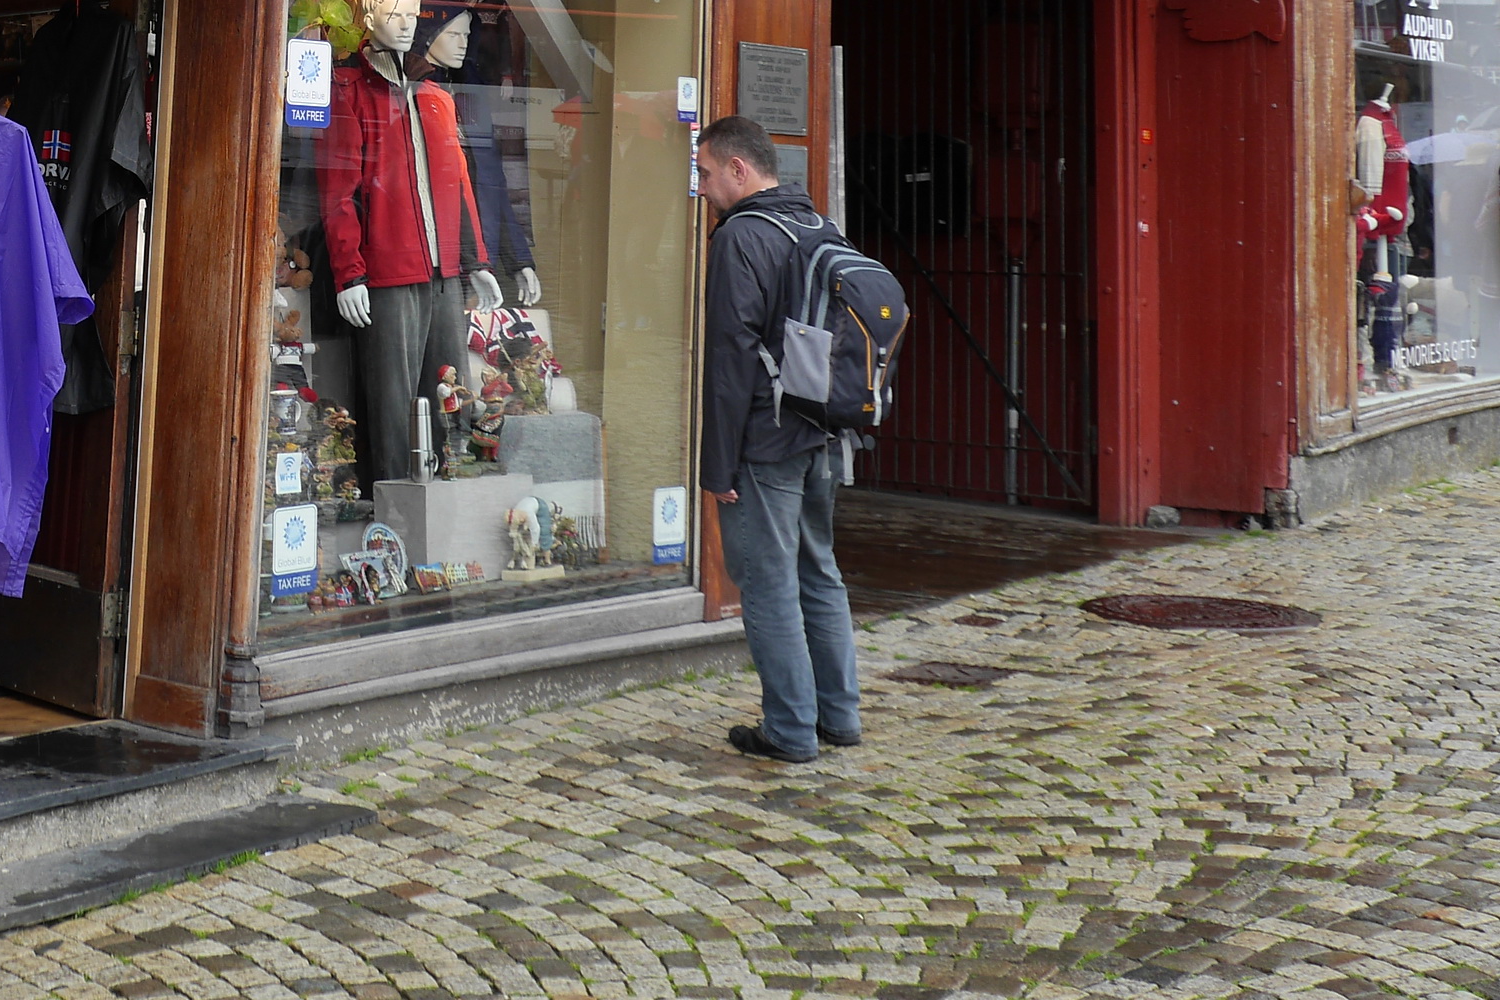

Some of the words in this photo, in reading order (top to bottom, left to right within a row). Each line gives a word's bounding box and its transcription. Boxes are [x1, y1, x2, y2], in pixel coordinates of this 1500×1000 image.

[1403, 13, 1453, 40] AUDHILD
[1410, 38, 1445, 62] VIKEN
[291, 109, 306, 121] TAX
[306, 109, 325, 122] FREE
[1391, 342, 1442, 369] MEMORIES
[1443, 342, 1451, 362] &
[1451, 338, 1477, 362] GIFTS
[277, 557, 297, 568] Global
[297, 555, 312, 565] Blue
[277, 577, 293, 591] TAX
[293, 574, 312, 588] FREE
